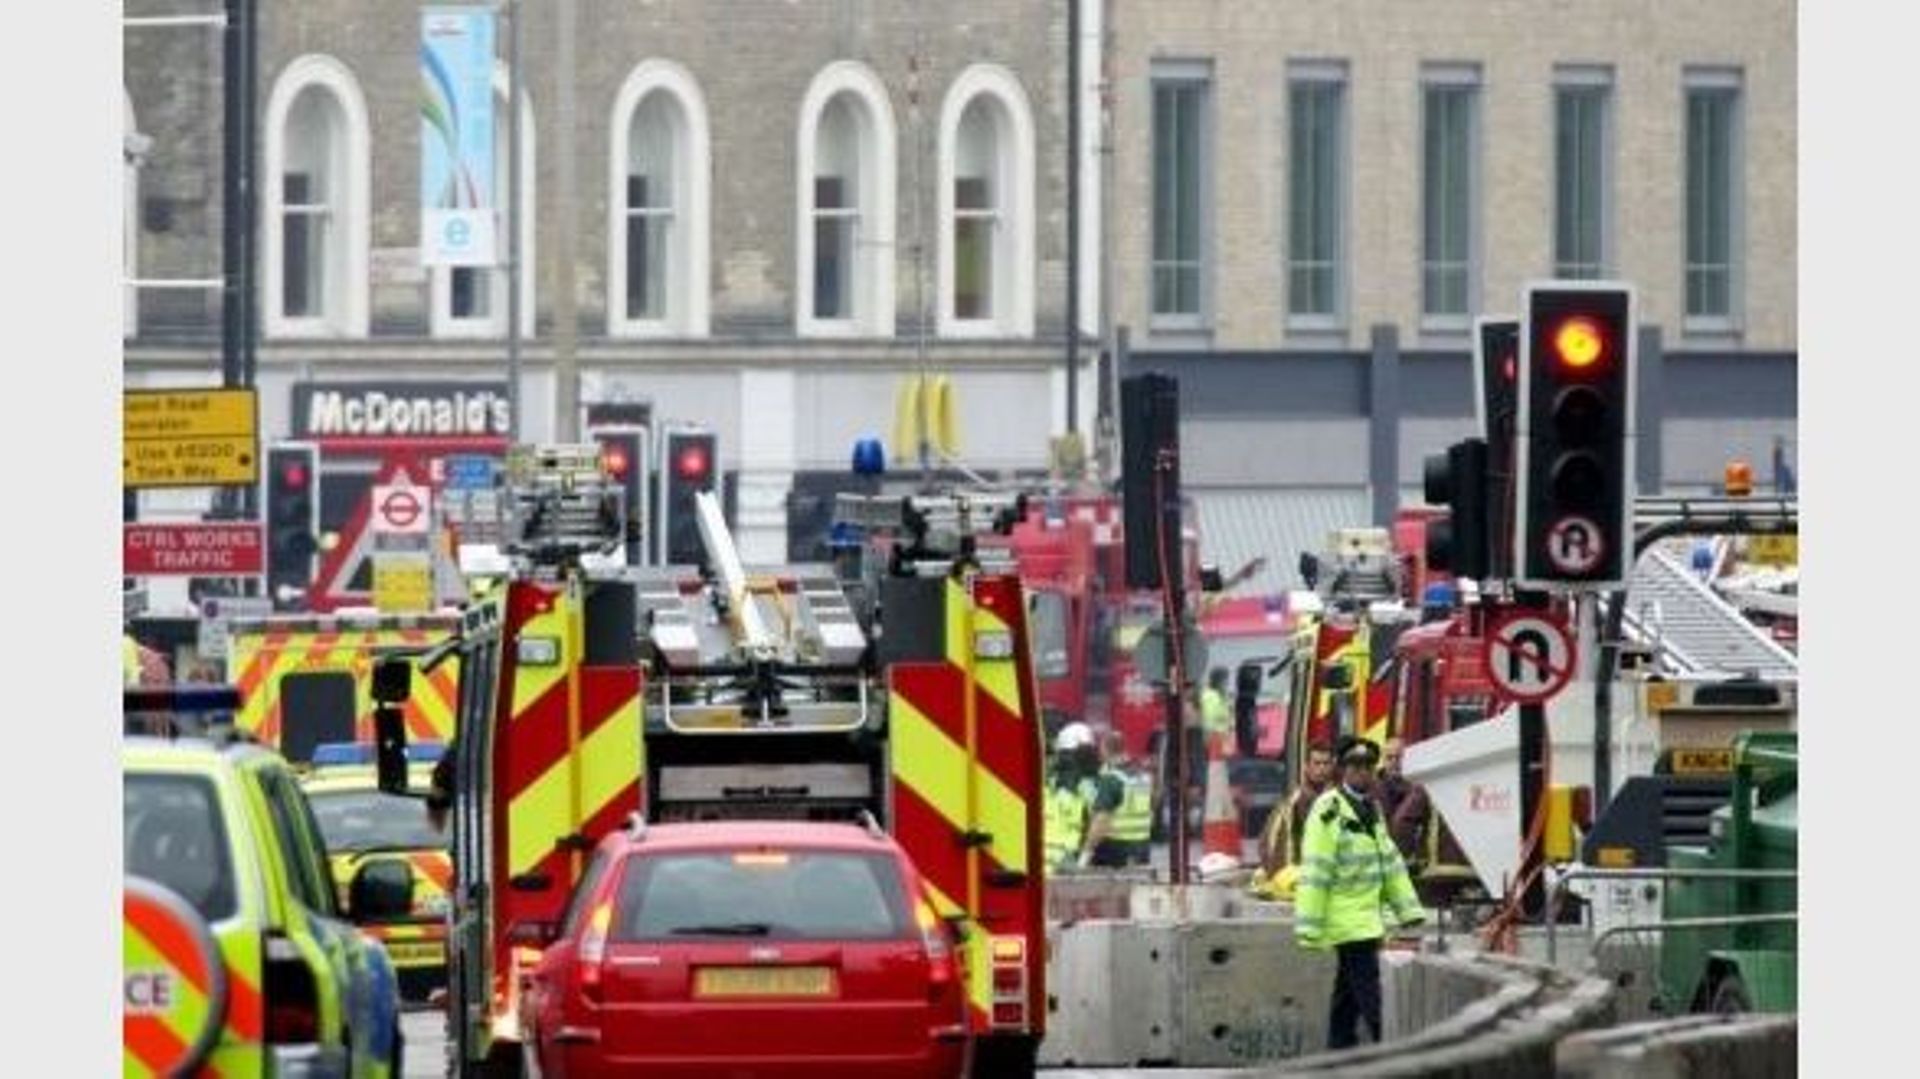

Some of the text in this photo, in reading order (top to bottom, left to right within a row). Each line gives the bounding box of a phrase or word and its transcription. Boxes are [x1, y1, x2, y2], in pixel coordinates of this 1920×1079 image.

[310, 391, 510, 434] McDonald's
[127, 530, 257, 549] CTRL WORKS
[154, 550, 235, 568] TRAFFIC
